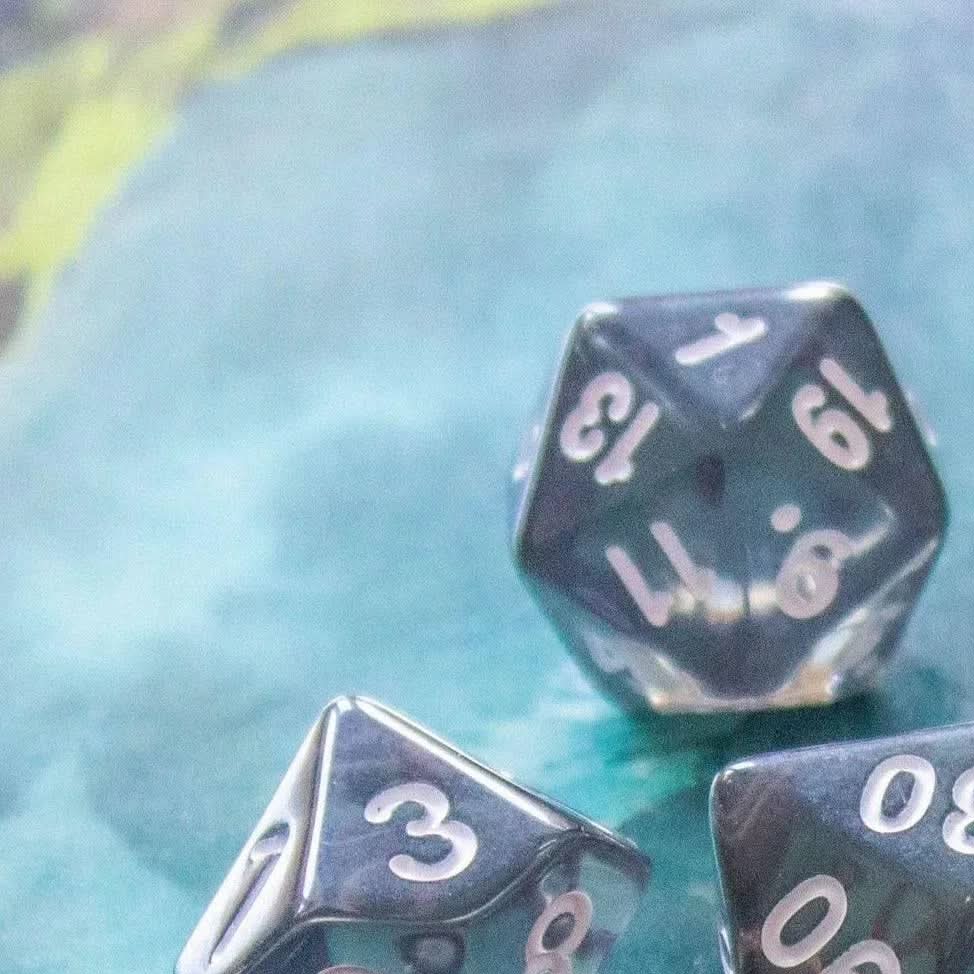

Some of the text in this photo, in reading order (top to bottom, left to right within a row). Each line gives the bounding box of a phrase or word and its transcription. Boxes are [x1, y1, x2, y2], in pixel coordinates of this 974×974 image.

[675, 313, 767, 366] 1
[560, 371, 659, 485] 13
[792, 358, 893, 471] 19
[364, 783, 478, 881] 3
